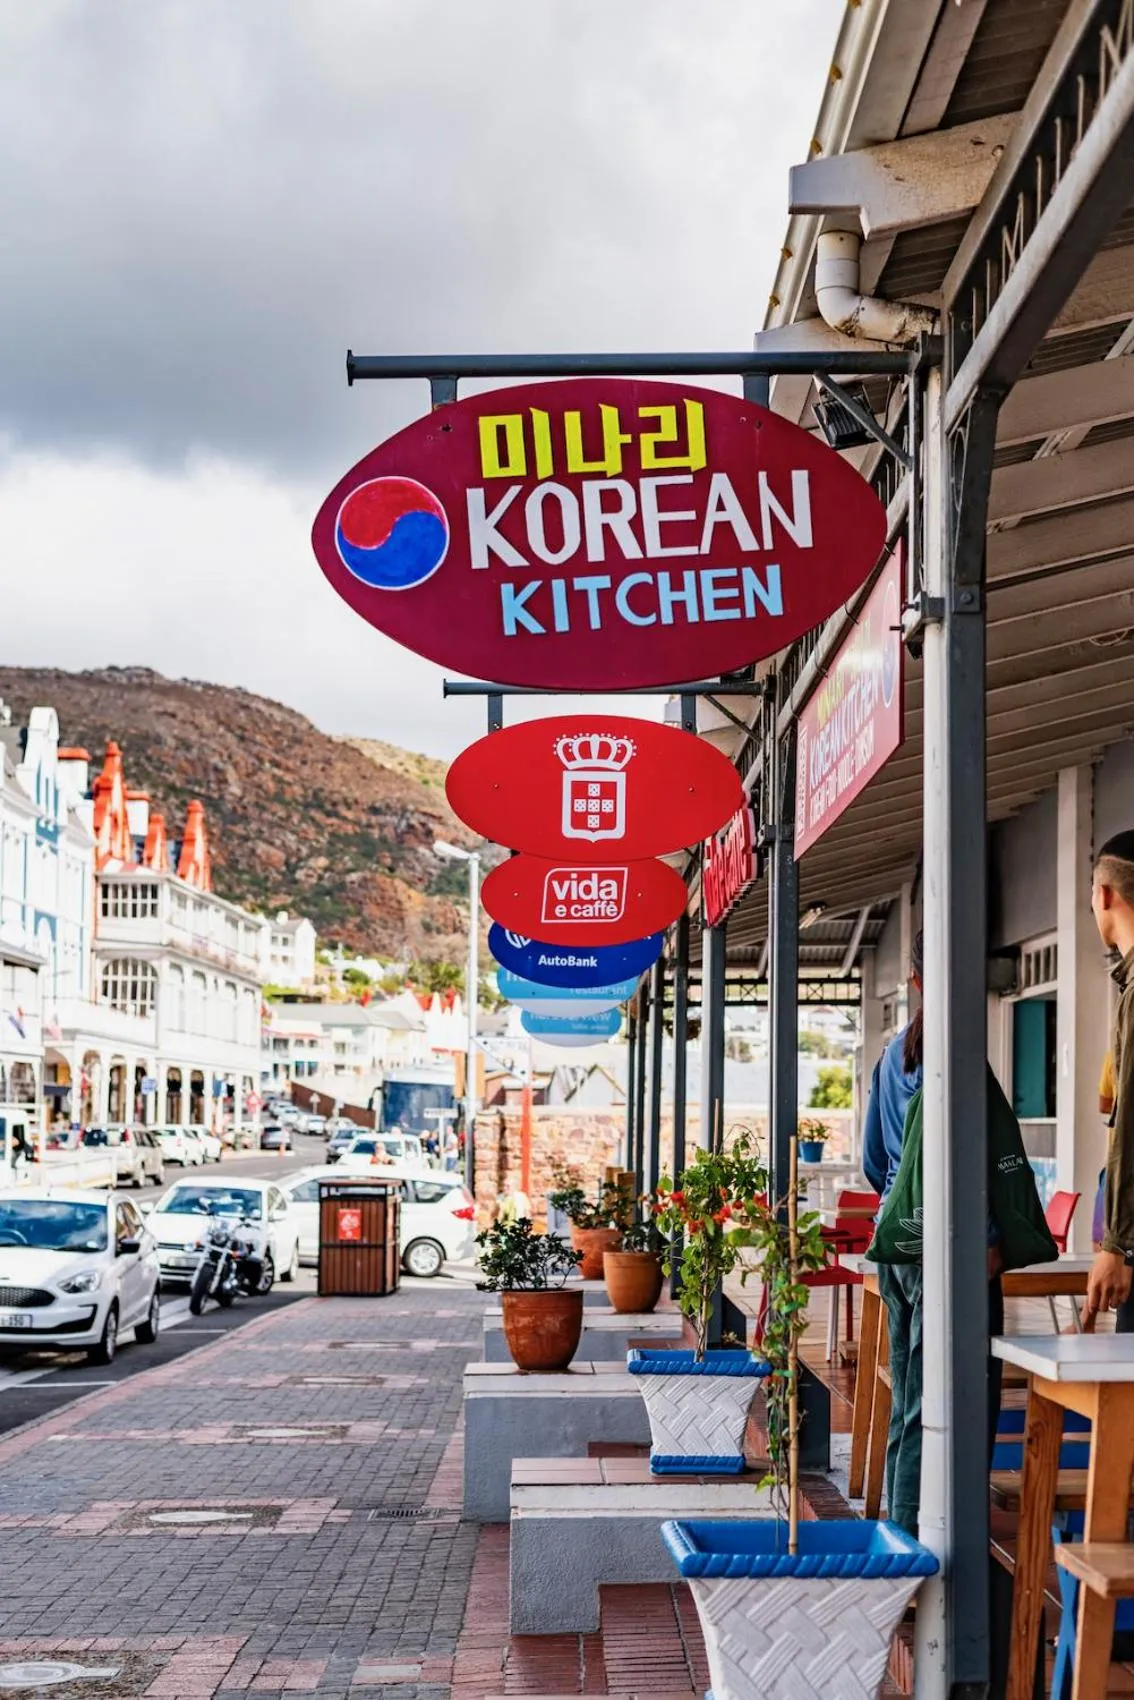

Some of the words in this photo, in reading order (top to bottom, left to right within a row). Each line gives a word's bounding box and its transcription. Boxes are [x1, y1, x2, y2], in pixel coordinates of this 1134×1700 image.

[478, 399, 707, 480] 미나리
[466, 469, 814, 570] KOREAN
[500, 564, 784, 636] KITCHEN
[551, 872, 618, 901] vida
[554, 904, 567, 918] e
[570, 900, 618, 918] caffè
[538, 954, 598, 968] AutoBank
